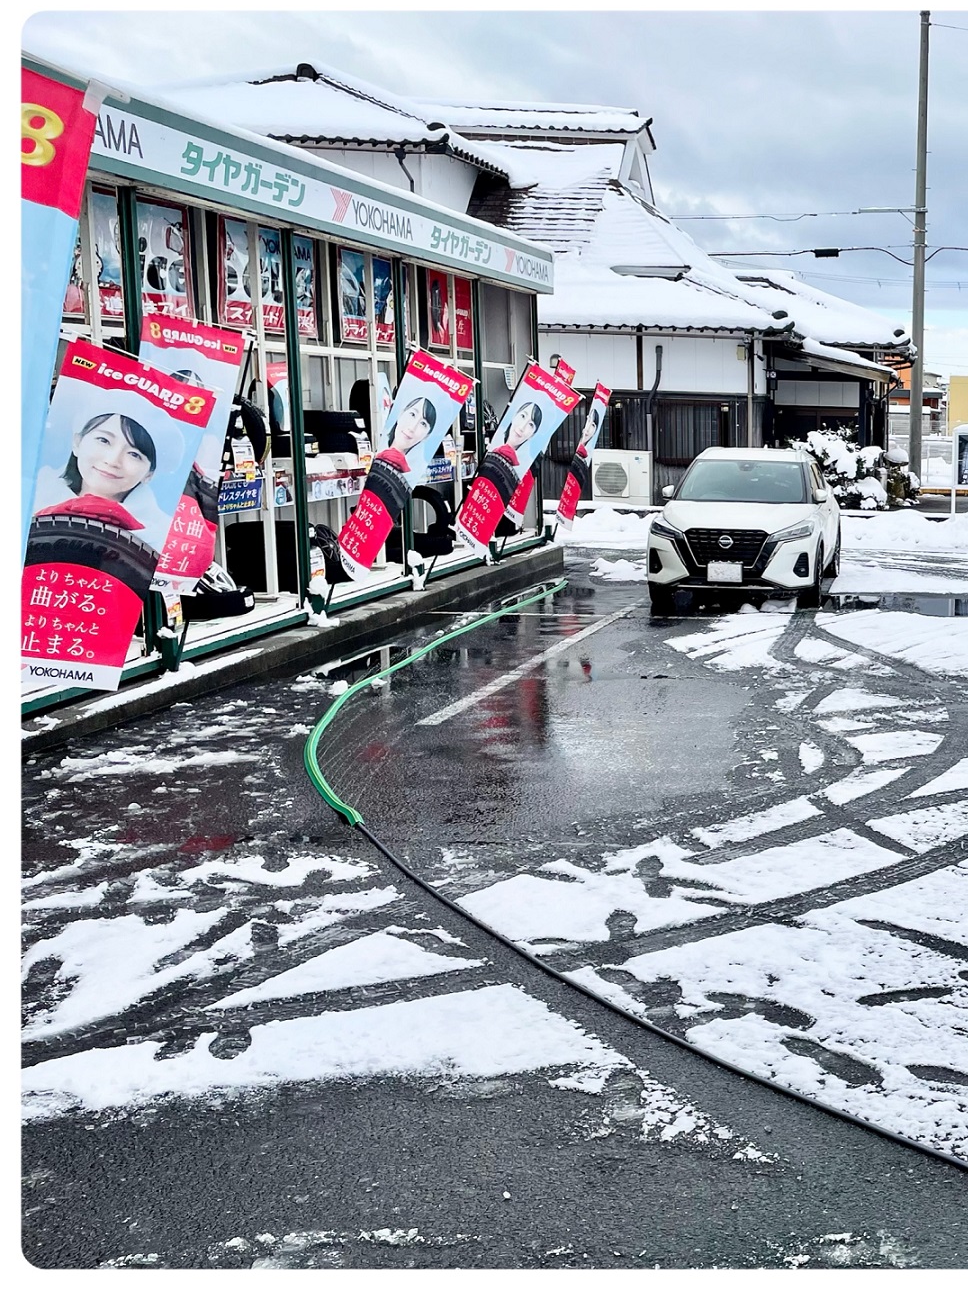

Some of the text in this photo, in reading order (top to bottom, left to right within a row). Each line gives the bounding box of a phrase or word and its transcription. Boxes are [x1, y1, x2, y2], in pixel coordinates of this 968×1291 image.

[181, 141, 306, 207] タイヤガーデン
[352, 198, 414, 241] YOKOHAMA
[430, 225, 492, 264] タイヤガーデン
[515, 255, 550, 282] YOKOHAMA
[74, 358, 206, 415] NEW iceGUARD 8
[458, 384, 469, 396] 8
[563, 396, 575, 406] 8
[35, 569, 114, 593] よりちゃんと
[30, 585, 106, 616] 曲がる。
[24, 614, 100, 636] よりちゃんと
[21, 631, 95, 659] 止まる。
[29, 665, 94, 682] YOKOHAMA
